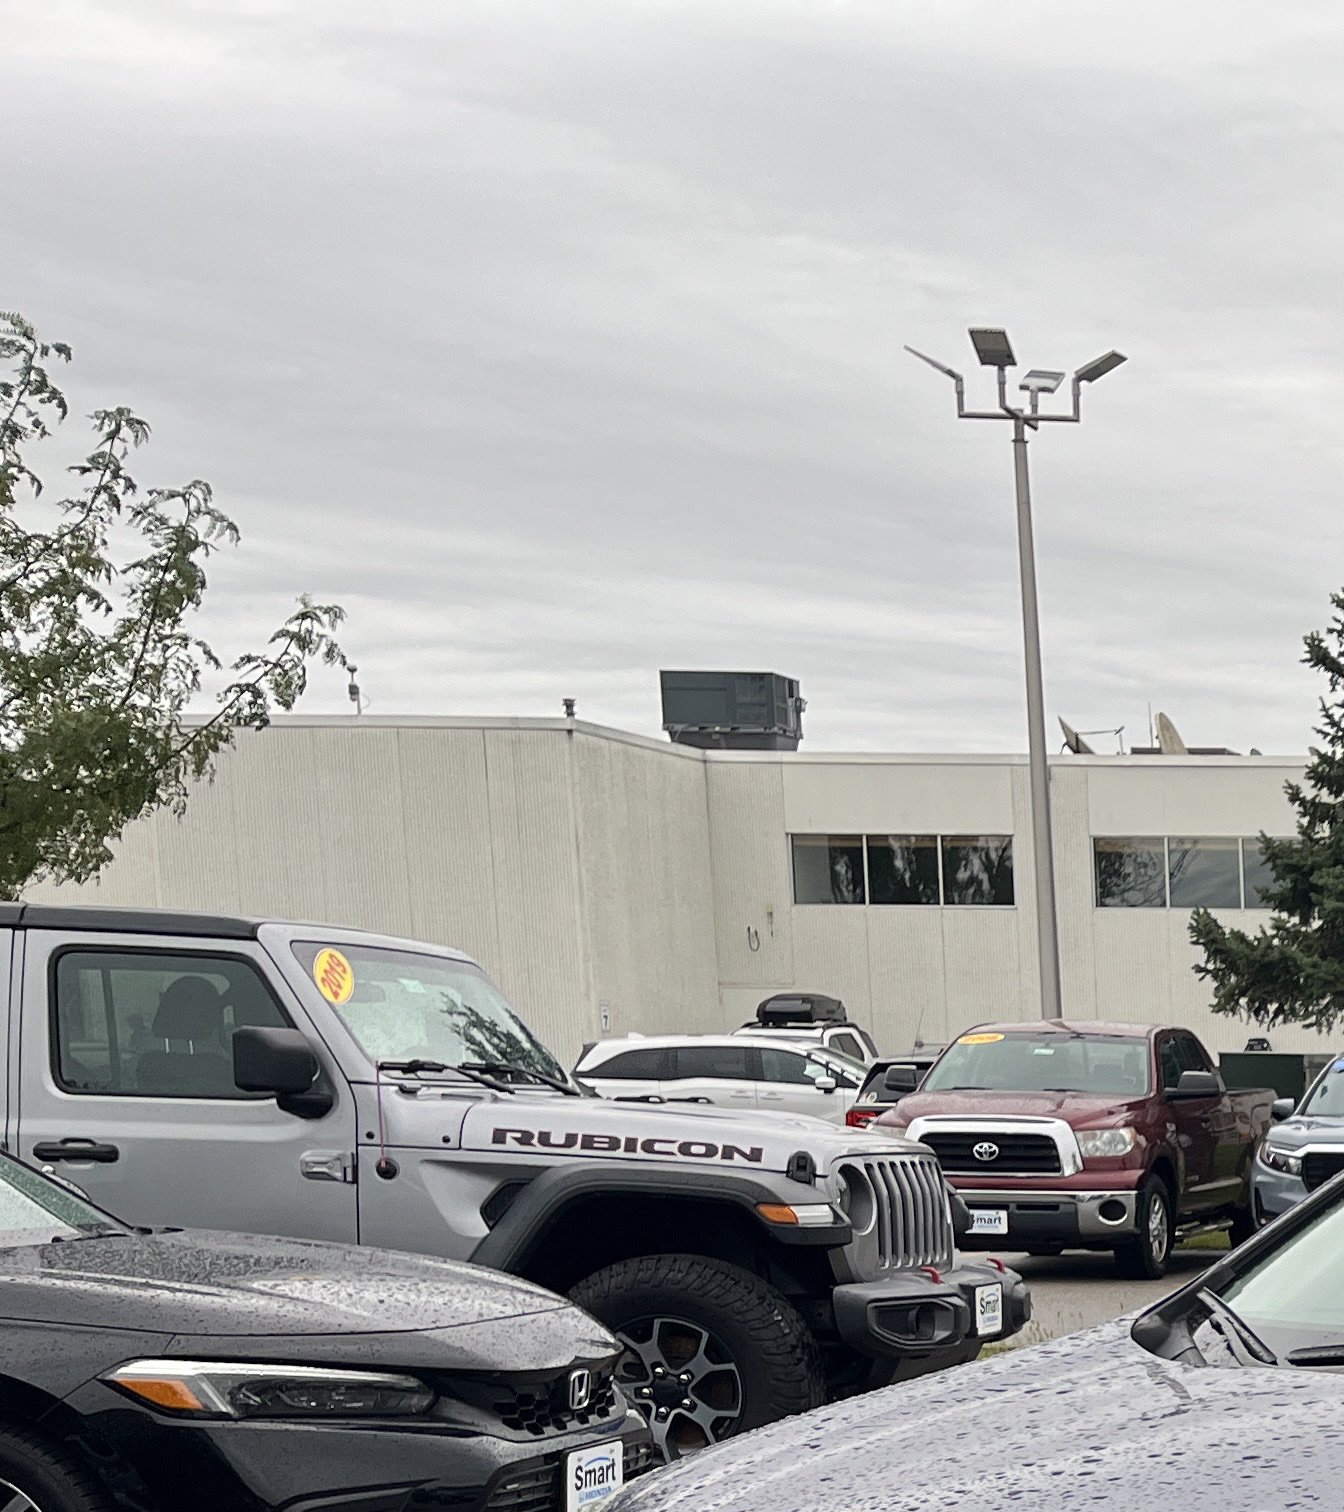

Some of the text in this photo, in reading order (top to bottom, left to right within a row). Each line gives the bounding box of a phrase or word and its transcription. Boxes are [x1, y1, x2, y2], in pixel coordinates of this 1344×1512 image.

[320, 953, 347, 1000] 2019
[491, 1127, 764, 1163] RUBICON
[974, 1216, 1002, 1225] mart
[574, 1458, 617, 1491] Smart
